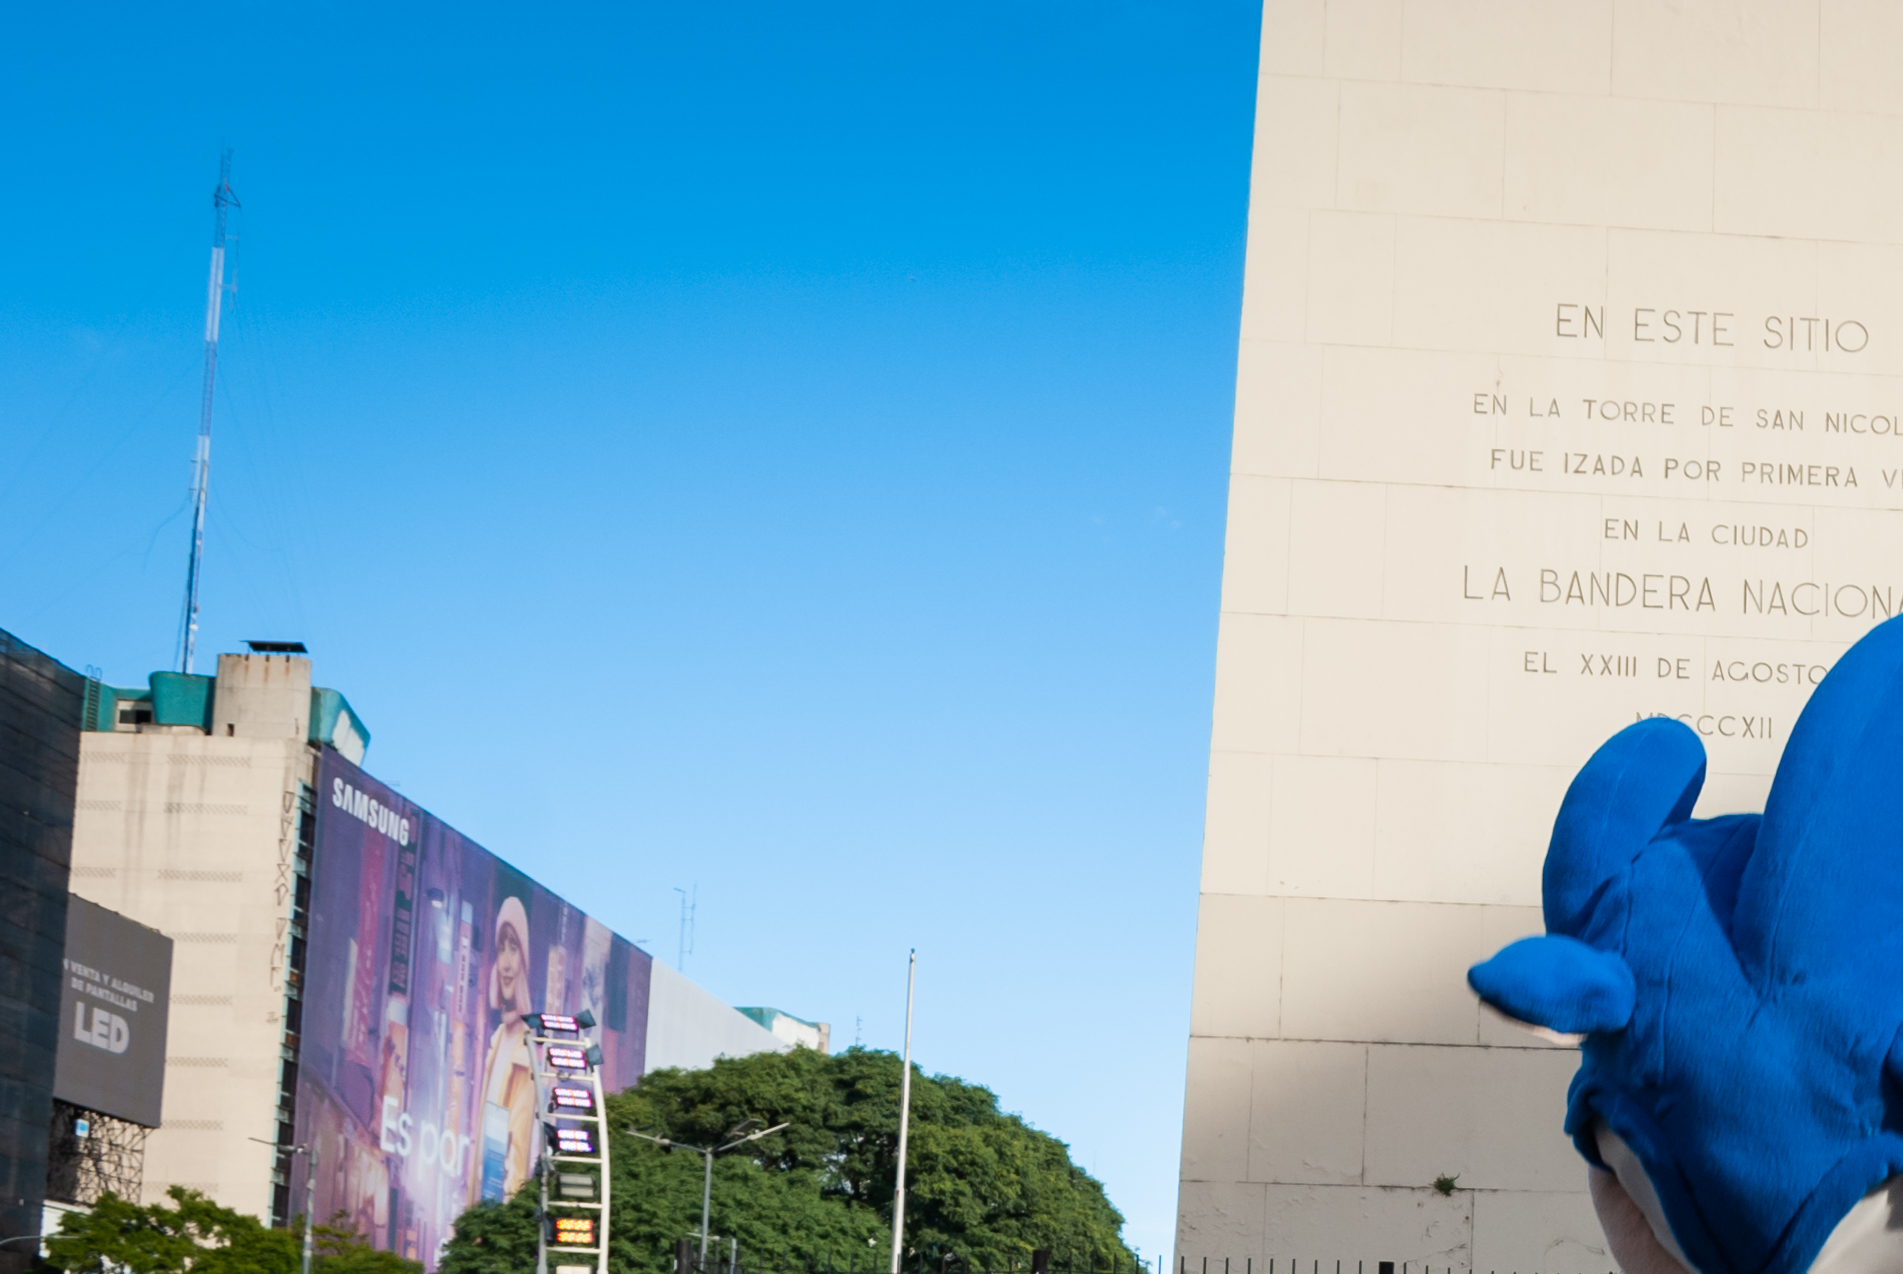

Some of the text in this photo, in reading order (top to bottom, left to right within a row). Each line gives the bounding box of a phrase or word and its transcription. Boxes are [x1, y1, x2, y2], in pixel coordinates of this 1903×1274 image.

[1555, 303, 1870, 353] EN ESTE SITIO
[1472, 392, 1508, 416] EN
[1529, 396, 1562, 419] LA
[1582, 398, 1676, 426] TORRE
[1700, 405, 1735, 429] DE
[1755, 408, 1805, 433] SAN
[1490, 447, 1544, 473] FUE
[1563, 451, 1645, 480] IZADA
[1663, 457, 1722, 484] POR
[1741, 461, 1859, 490] PRIMERA
[1604, 518, 1810, 550] EN LA CIUDAD
[1462, 564, 1512, 603] LA
[1539, 567, 1717, 614] BANDERA
[1523, 650, 1829, 686] EL XXIII DE AGOSTO
[331, 777, 410, 847] SAMSUNG
[73, 1001, 131, 1055] LED
[379, 1094, 470, 1182] Es por
